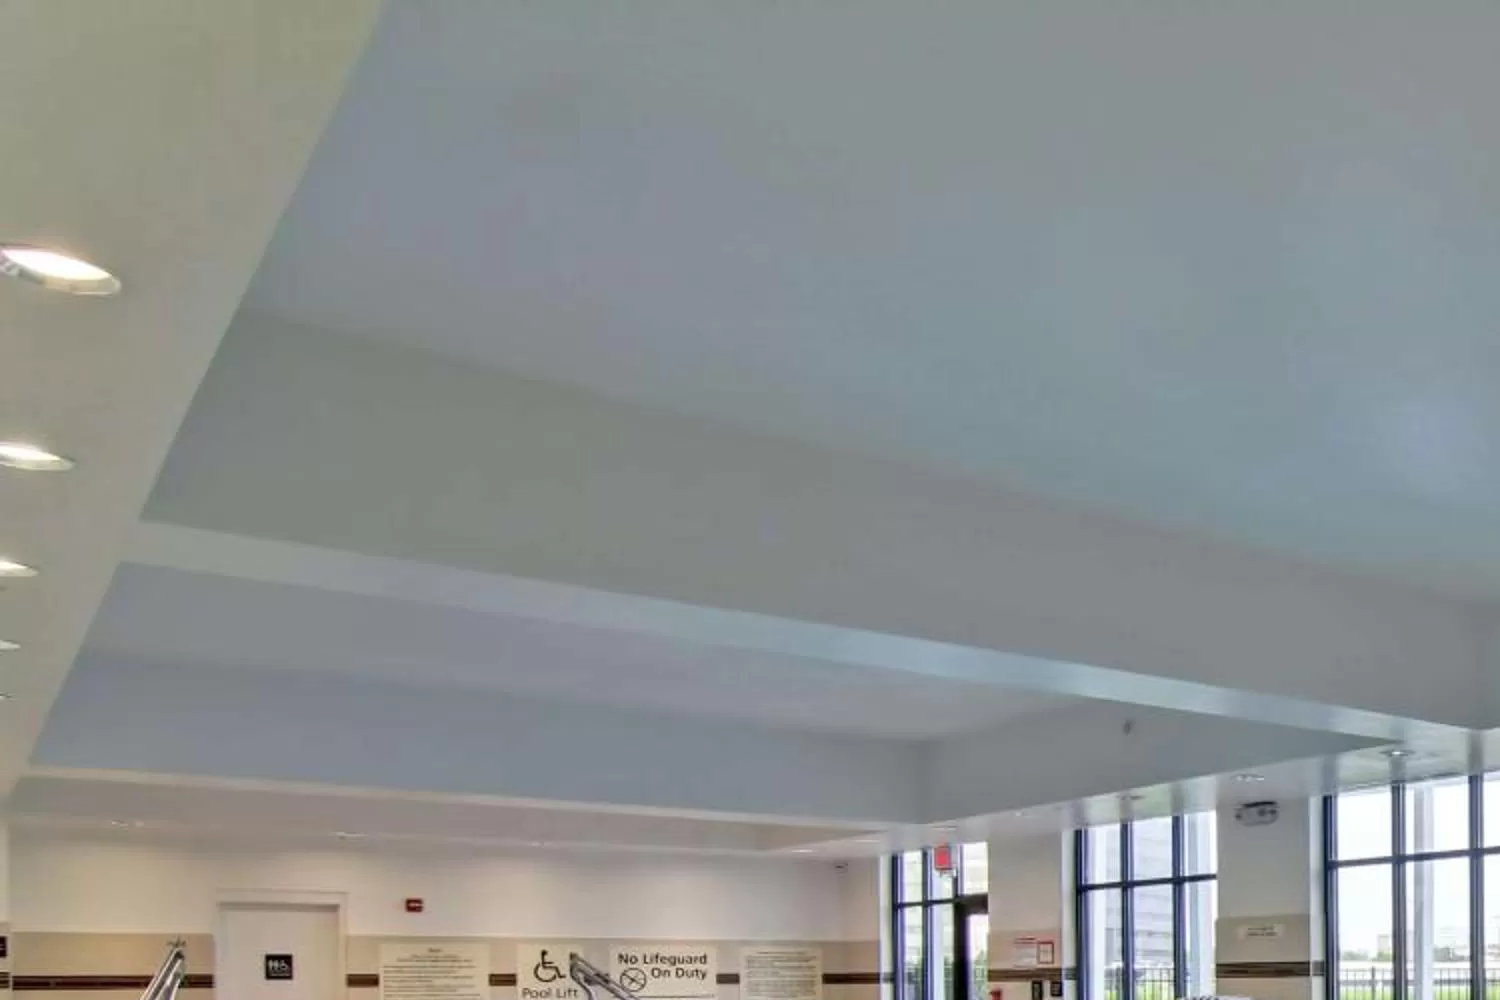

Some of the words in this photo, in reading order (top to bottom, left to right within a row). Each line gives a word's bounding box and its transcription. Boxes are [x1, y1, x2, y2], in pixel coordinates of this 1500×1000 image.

[617, 953, 639, 965] No
[643, 952, 708, 966] Lifeguard
[651, 967, 671, 979] On
[675, 967, 707, 980] Duty
[522, 987, 552, 999] Pool
[556, 987, 578, 999] Lift
